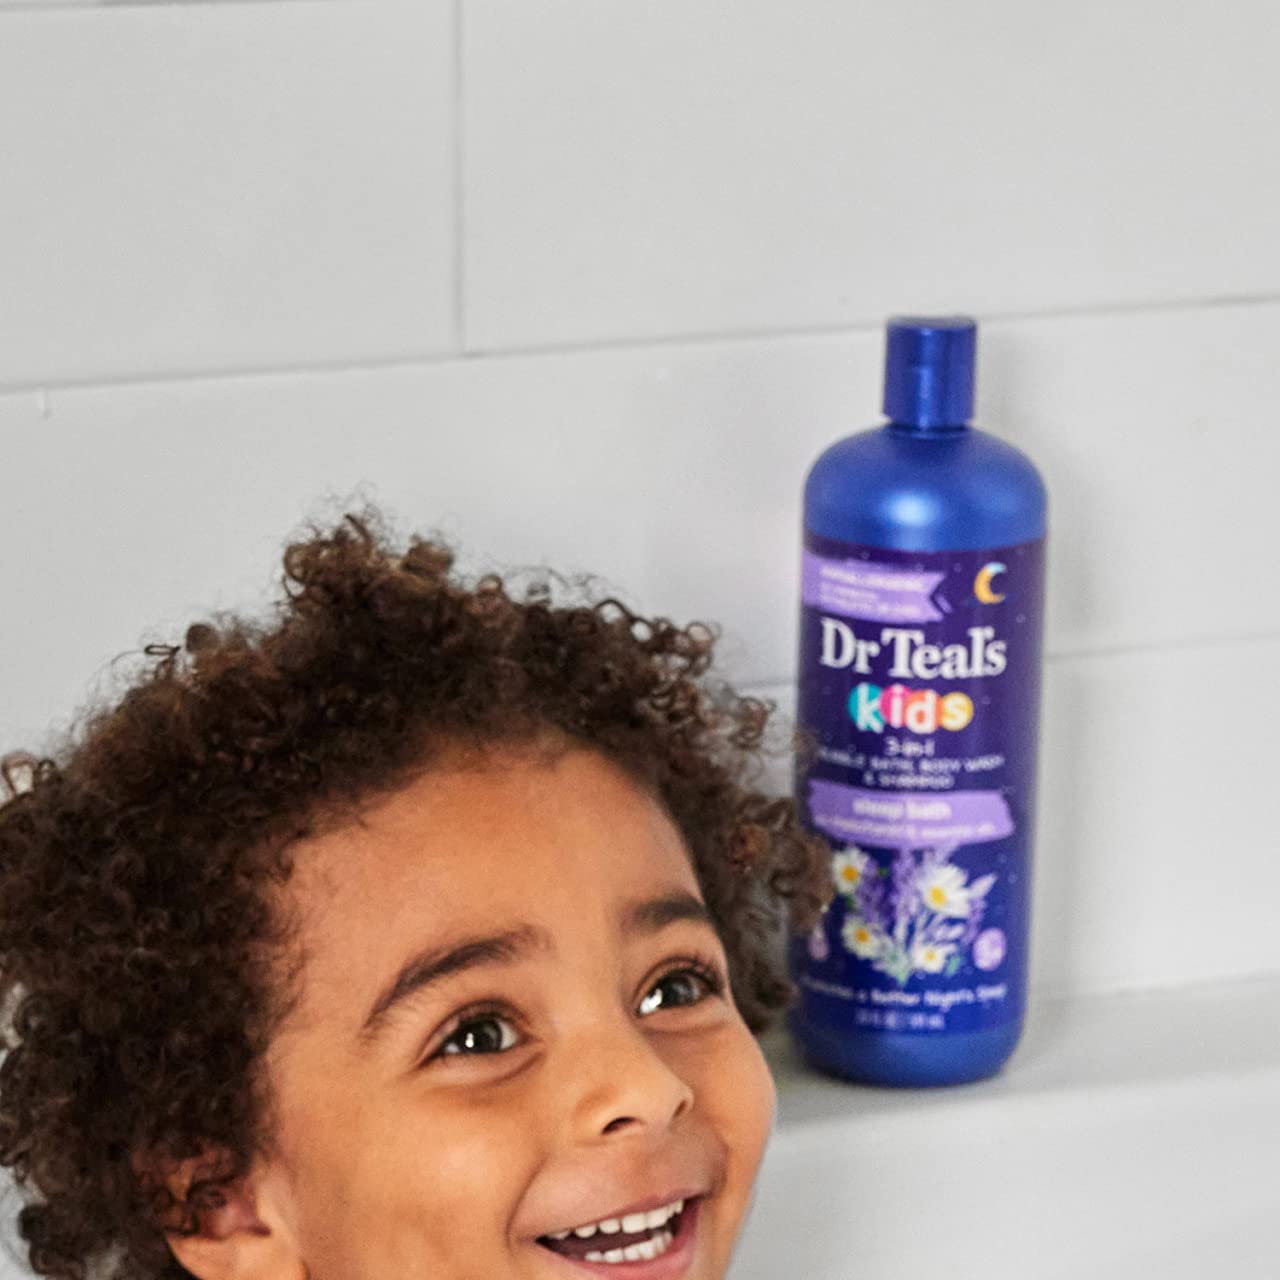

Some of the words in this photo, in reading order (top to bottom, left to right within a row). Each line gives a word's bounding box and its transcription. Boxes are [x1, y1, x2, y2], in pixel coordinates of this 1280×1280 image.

[820, 617, 881, 674] Dr
[880, 626, 1007, 680] Teal's
[853, 682, 973, 735] kids
